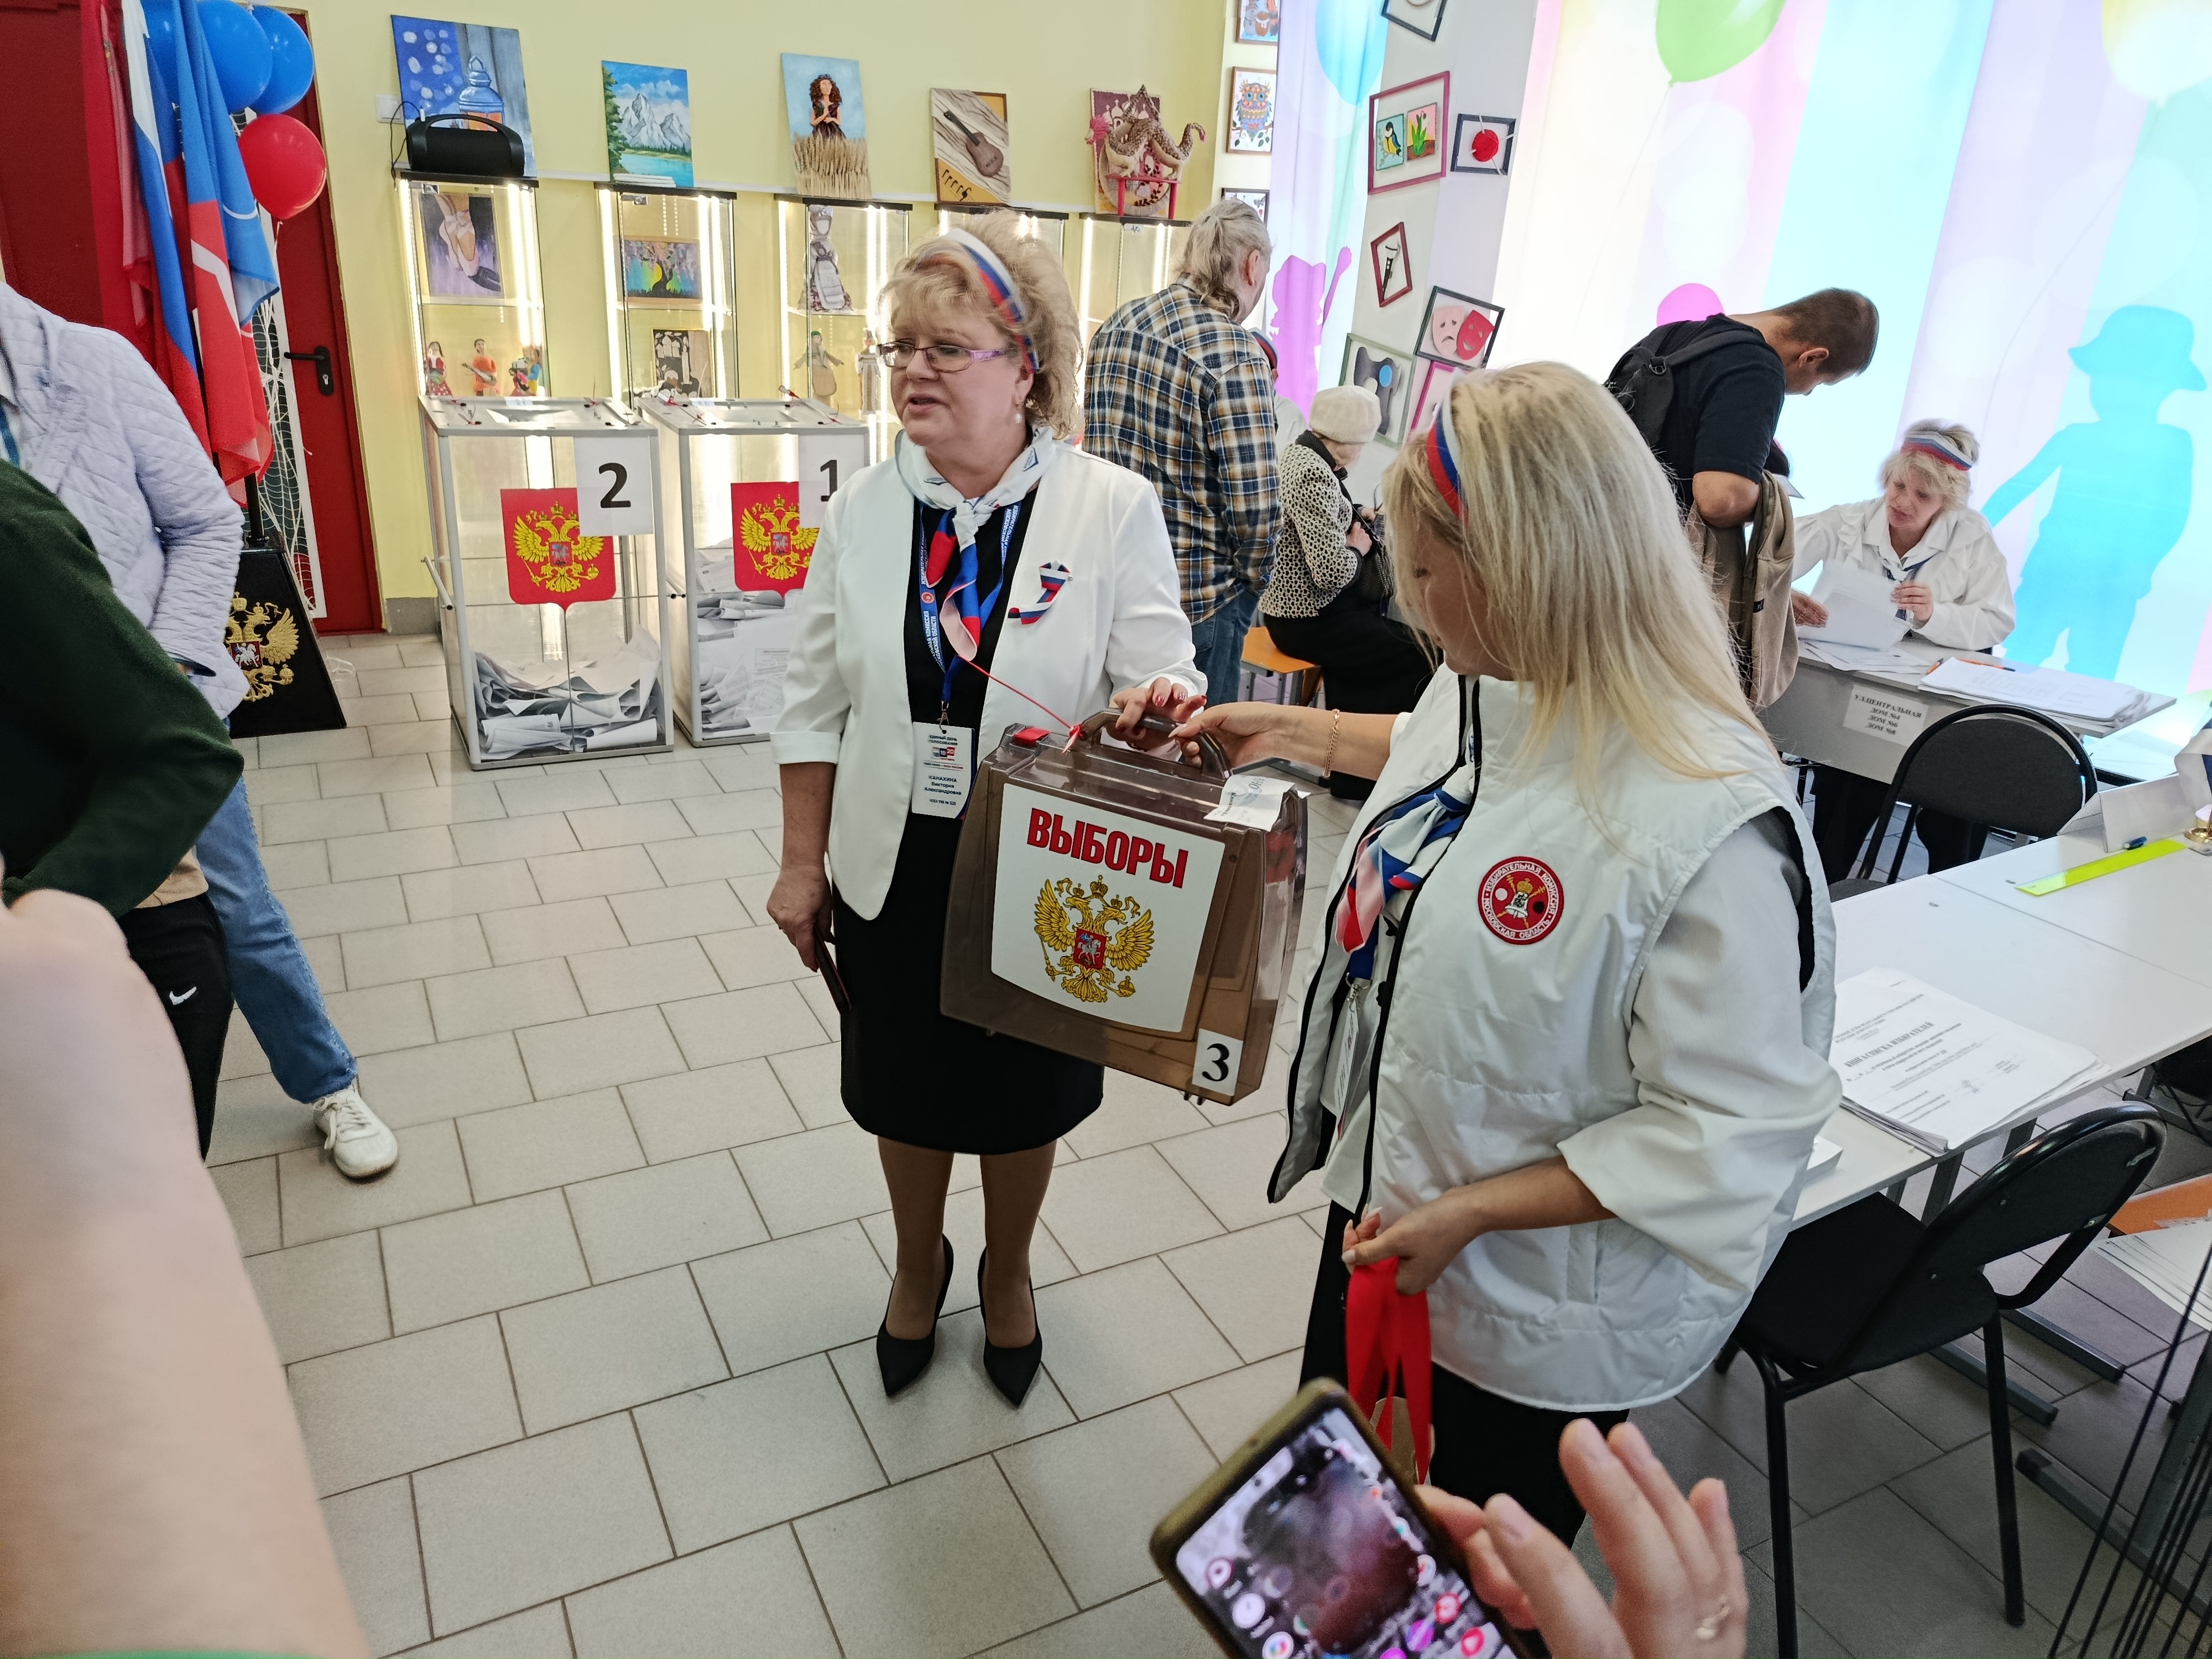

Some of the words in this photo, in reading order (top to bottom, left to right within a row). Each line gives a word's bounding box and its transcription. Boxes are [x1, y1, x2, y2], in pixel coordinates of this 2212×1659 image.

[598, 462, 632, 508] 2
[820, 460, 837, 502] 1
[1865, 722, 1884, 731] ДОМ
[1867, 715, 1886, 724] ДОМ
[1870, 707, 1888, 717] ДОМ
[1026, 807, 1188, 889] ВЫБОРЫ
[1485, 863, 1542, 891] ИЗБИРАТЕЛЬНАЯ
[1541, 874, 1557, 915] КОМИССИЯ
[1484, 898, 1516, 938] МОСКОВСКАЯ
[1519, 919, 1550, 939] ОБЛАСТЬ
[1201, 1043, 1230, 1082] 3
